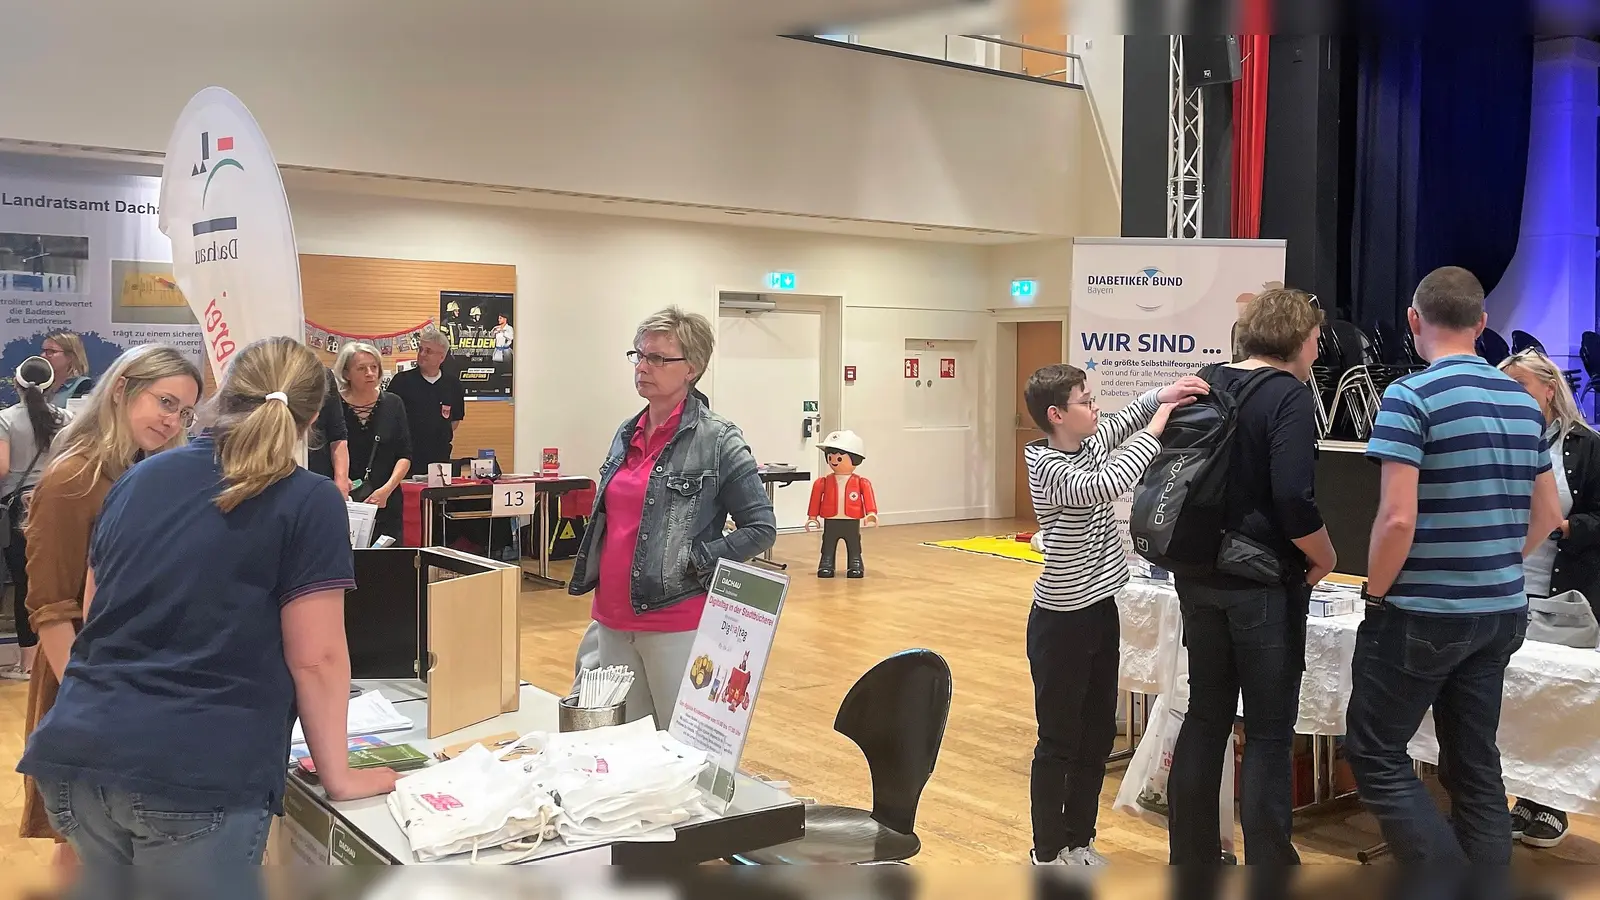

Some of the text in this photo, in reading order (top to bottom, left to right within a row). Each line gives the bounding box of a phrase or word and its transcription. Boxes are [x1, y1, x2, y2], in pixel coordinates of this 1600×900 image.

[2, 192, 110, 212] Landratsamt
[1088, 275, 1183, 287] DIABETIKER BUND
[1087, 286, 1114, 295] Bayern
[25, 308, 66, 316] Badeseen
[23, 317, 72, 325] Landkreises
[113, 330, 133, 339] trägt
[459, 338, 496, 349] HELDEN
[1081, 333, 1131, 352] WIR
[1138, 334, 1196, 353] SIND
[1102, 359, 1113, 367] die
[1114, 359, 1140, 370] größte
[1129, 369, 1140, 377] für
[1154, 370, 1188, 378] Menschen
[1135, 380, 1162, 388] Familien
[1154, 454, 1188, 525] ORTOVOX
[504, 492, 524, 507] 13
[721, 577, 742, 590] DACHAU
[708, 595, 729, 612] Digitaltag
[733, 604, 742, 615] der
